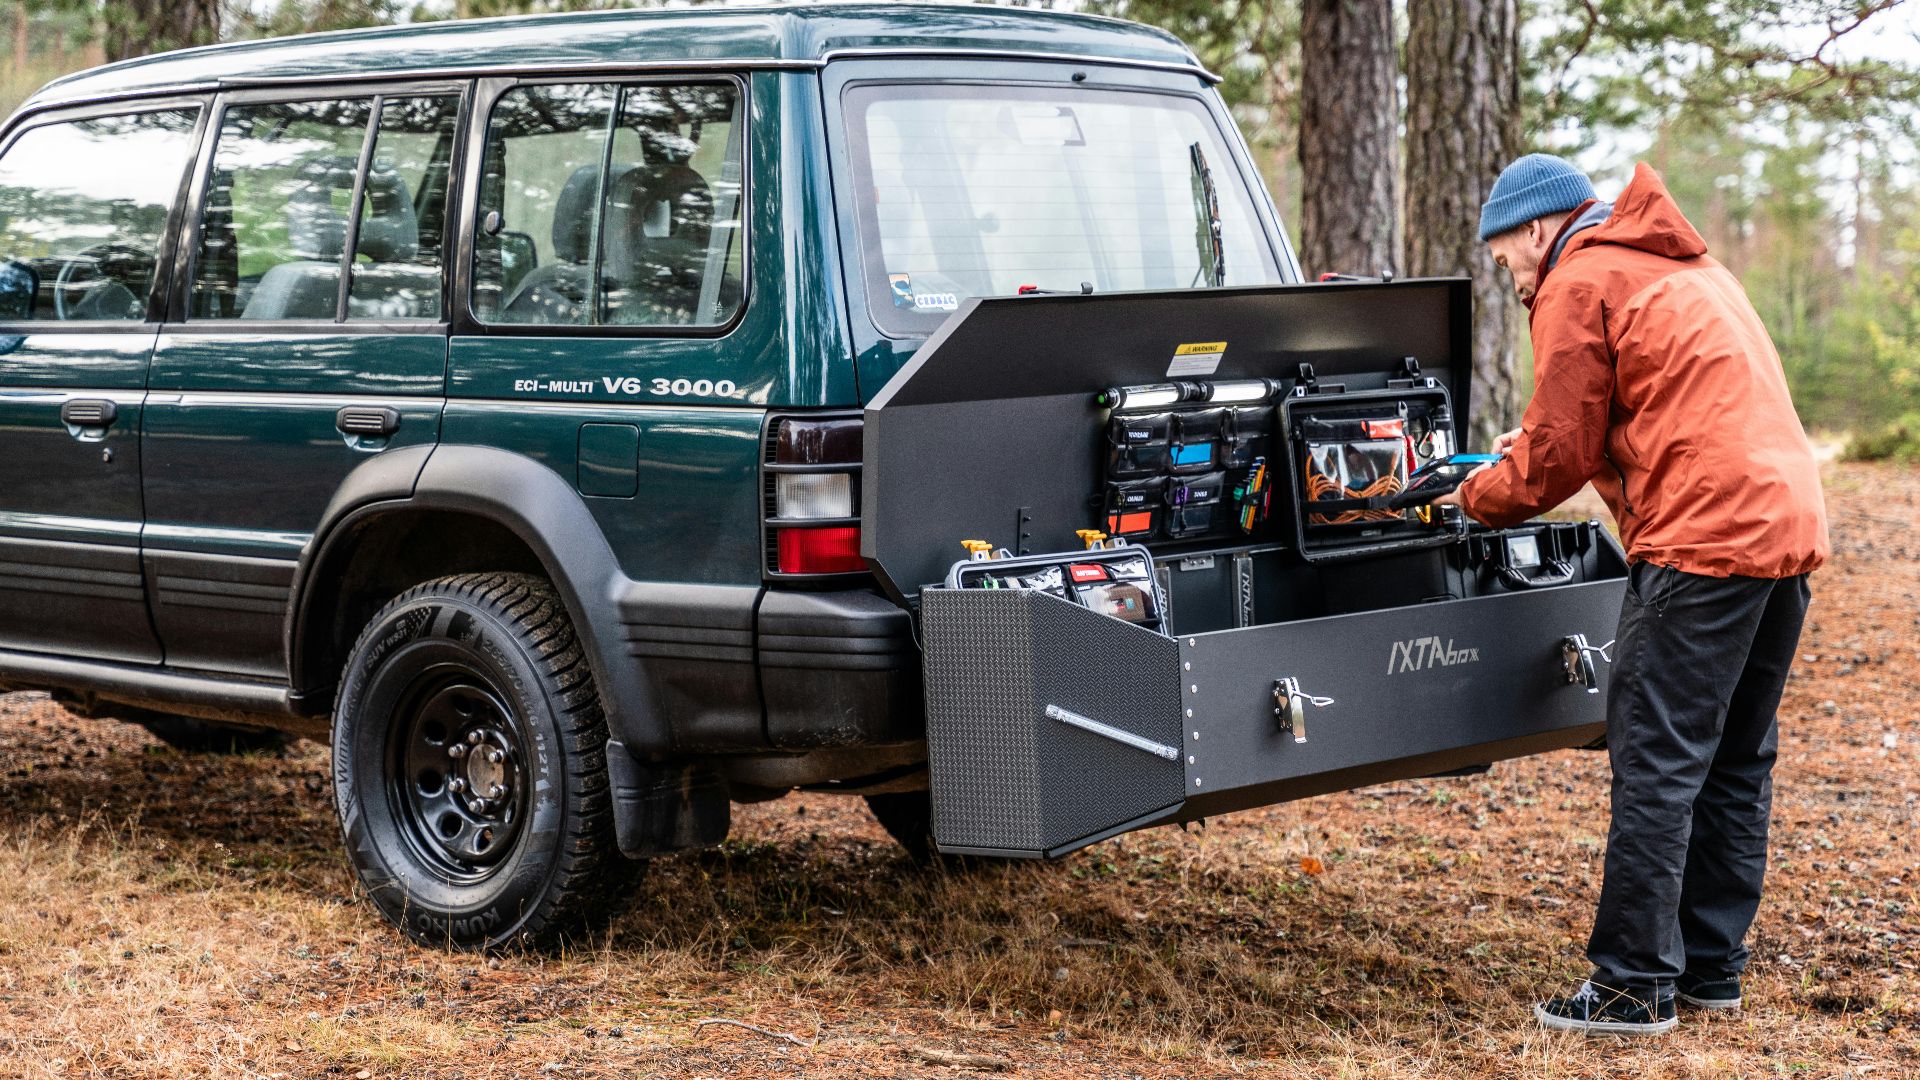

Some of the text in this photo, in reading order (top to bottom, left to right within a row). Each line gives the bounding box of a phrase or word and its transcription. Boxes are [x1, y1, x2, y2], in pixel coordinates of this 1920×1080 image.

[514, 376, 736, 397] ECI-MULTI V6 3000
[1386, 635, 1480, 676] IXTAbox
[416, 906, 502, 936] KUMHO
